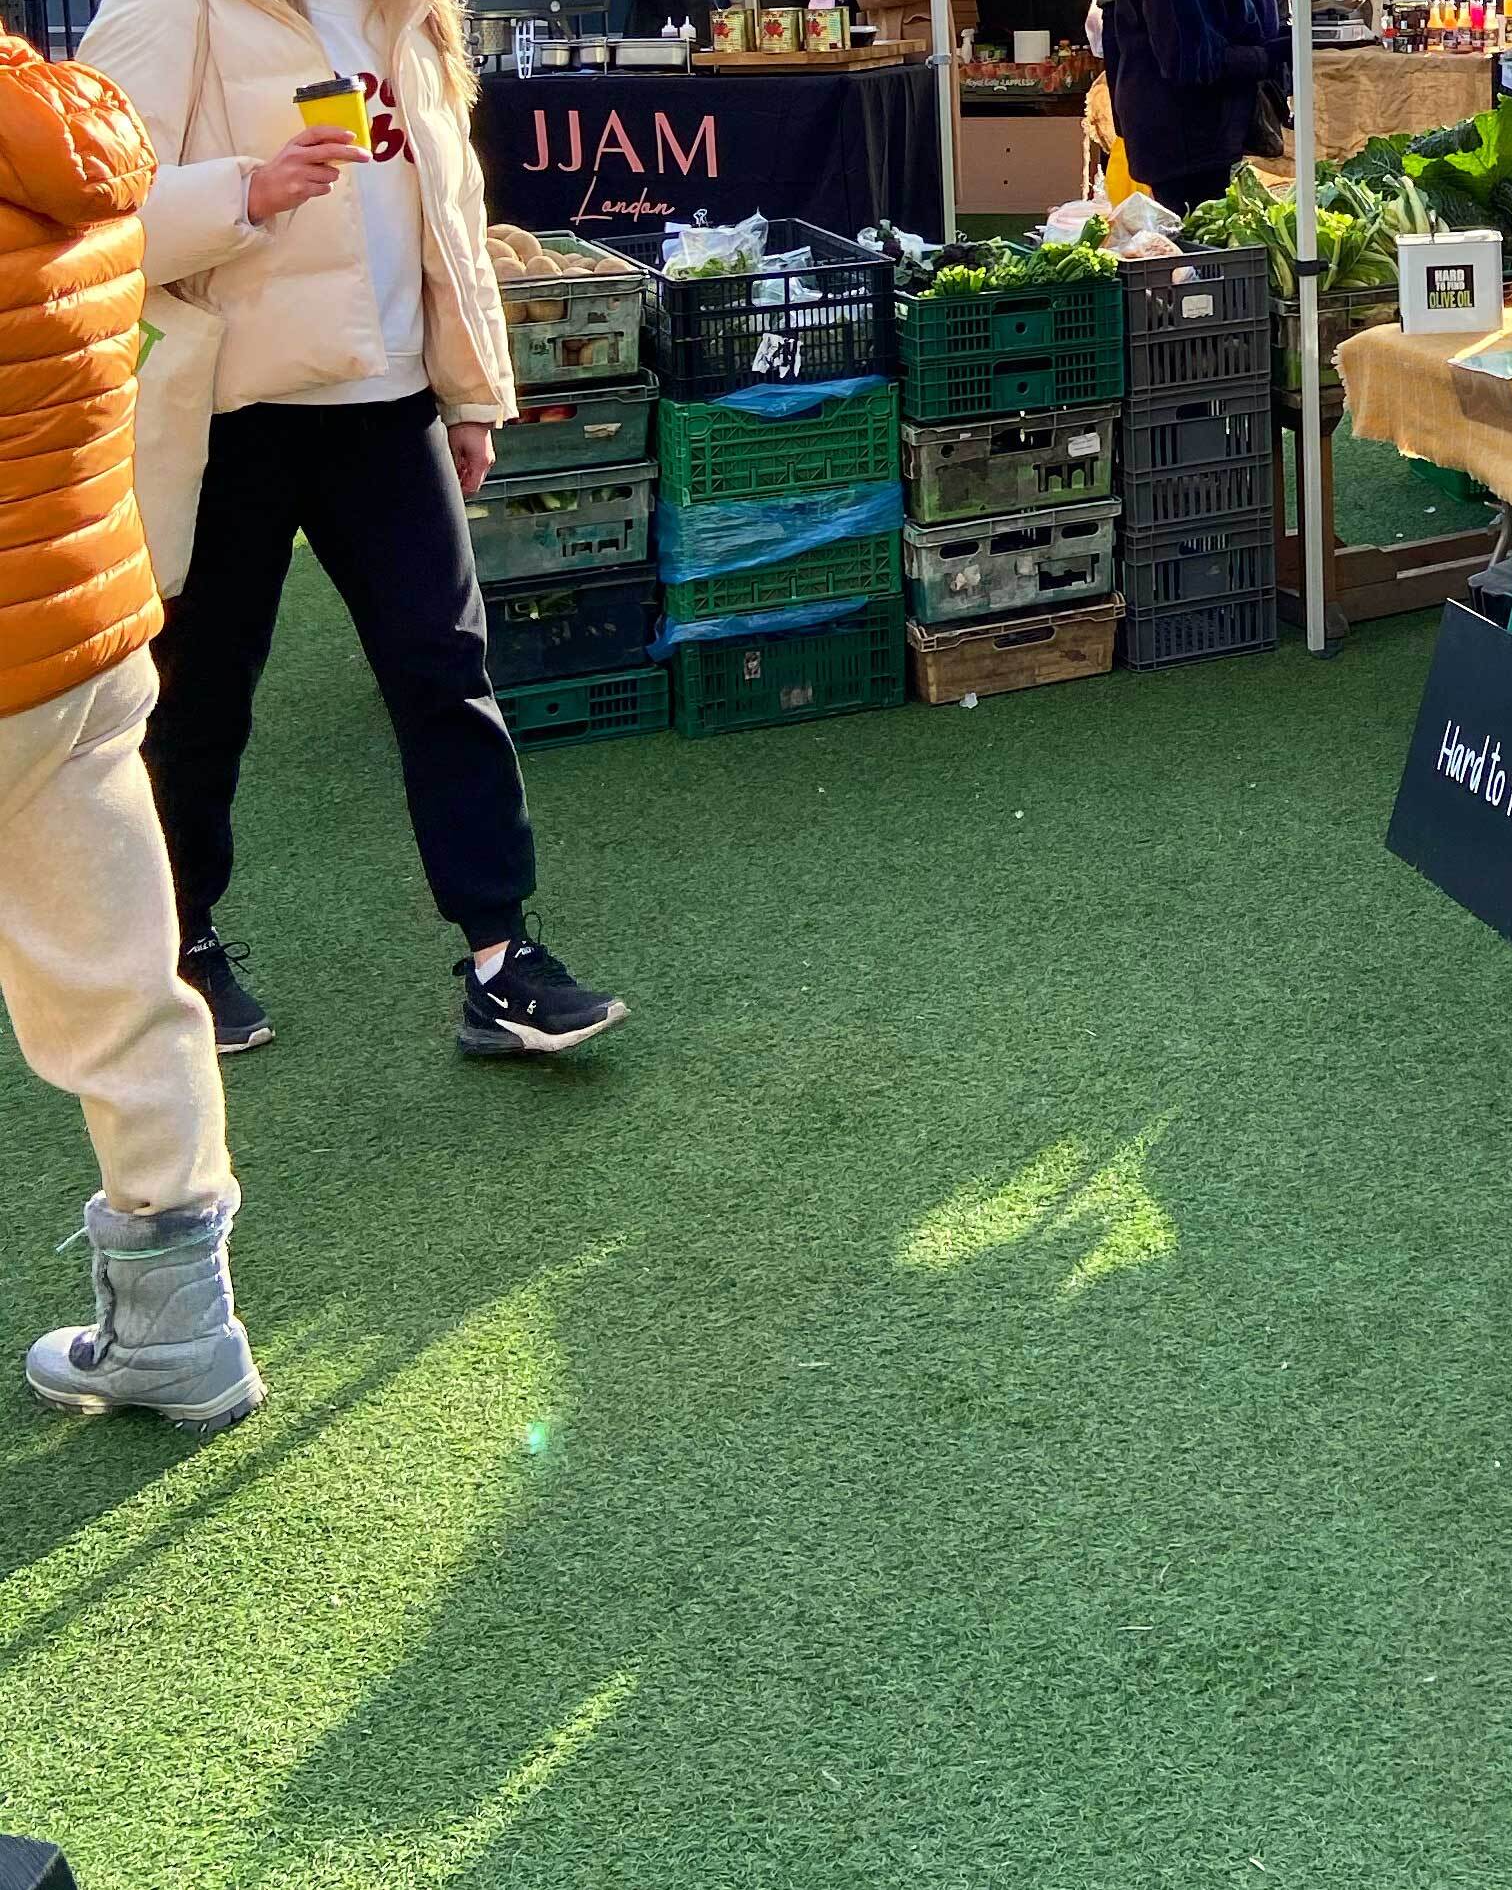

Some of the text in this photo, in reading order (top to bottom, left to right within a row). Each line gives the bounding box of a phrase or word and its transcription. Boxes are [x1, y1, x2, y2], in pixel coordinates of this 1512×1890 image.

[522, 109, 718, 178] JJAM
[569, 175, 676, 226] London
[1434, 269, 1465, 282] HARD
[1435, 281, 1466, 292] TO FIND
[1429, 290, 1473, 308] OLIVE OIL
[1437, 720, 1490, 794] Hard
[1486, 741, 1506, 806] to
